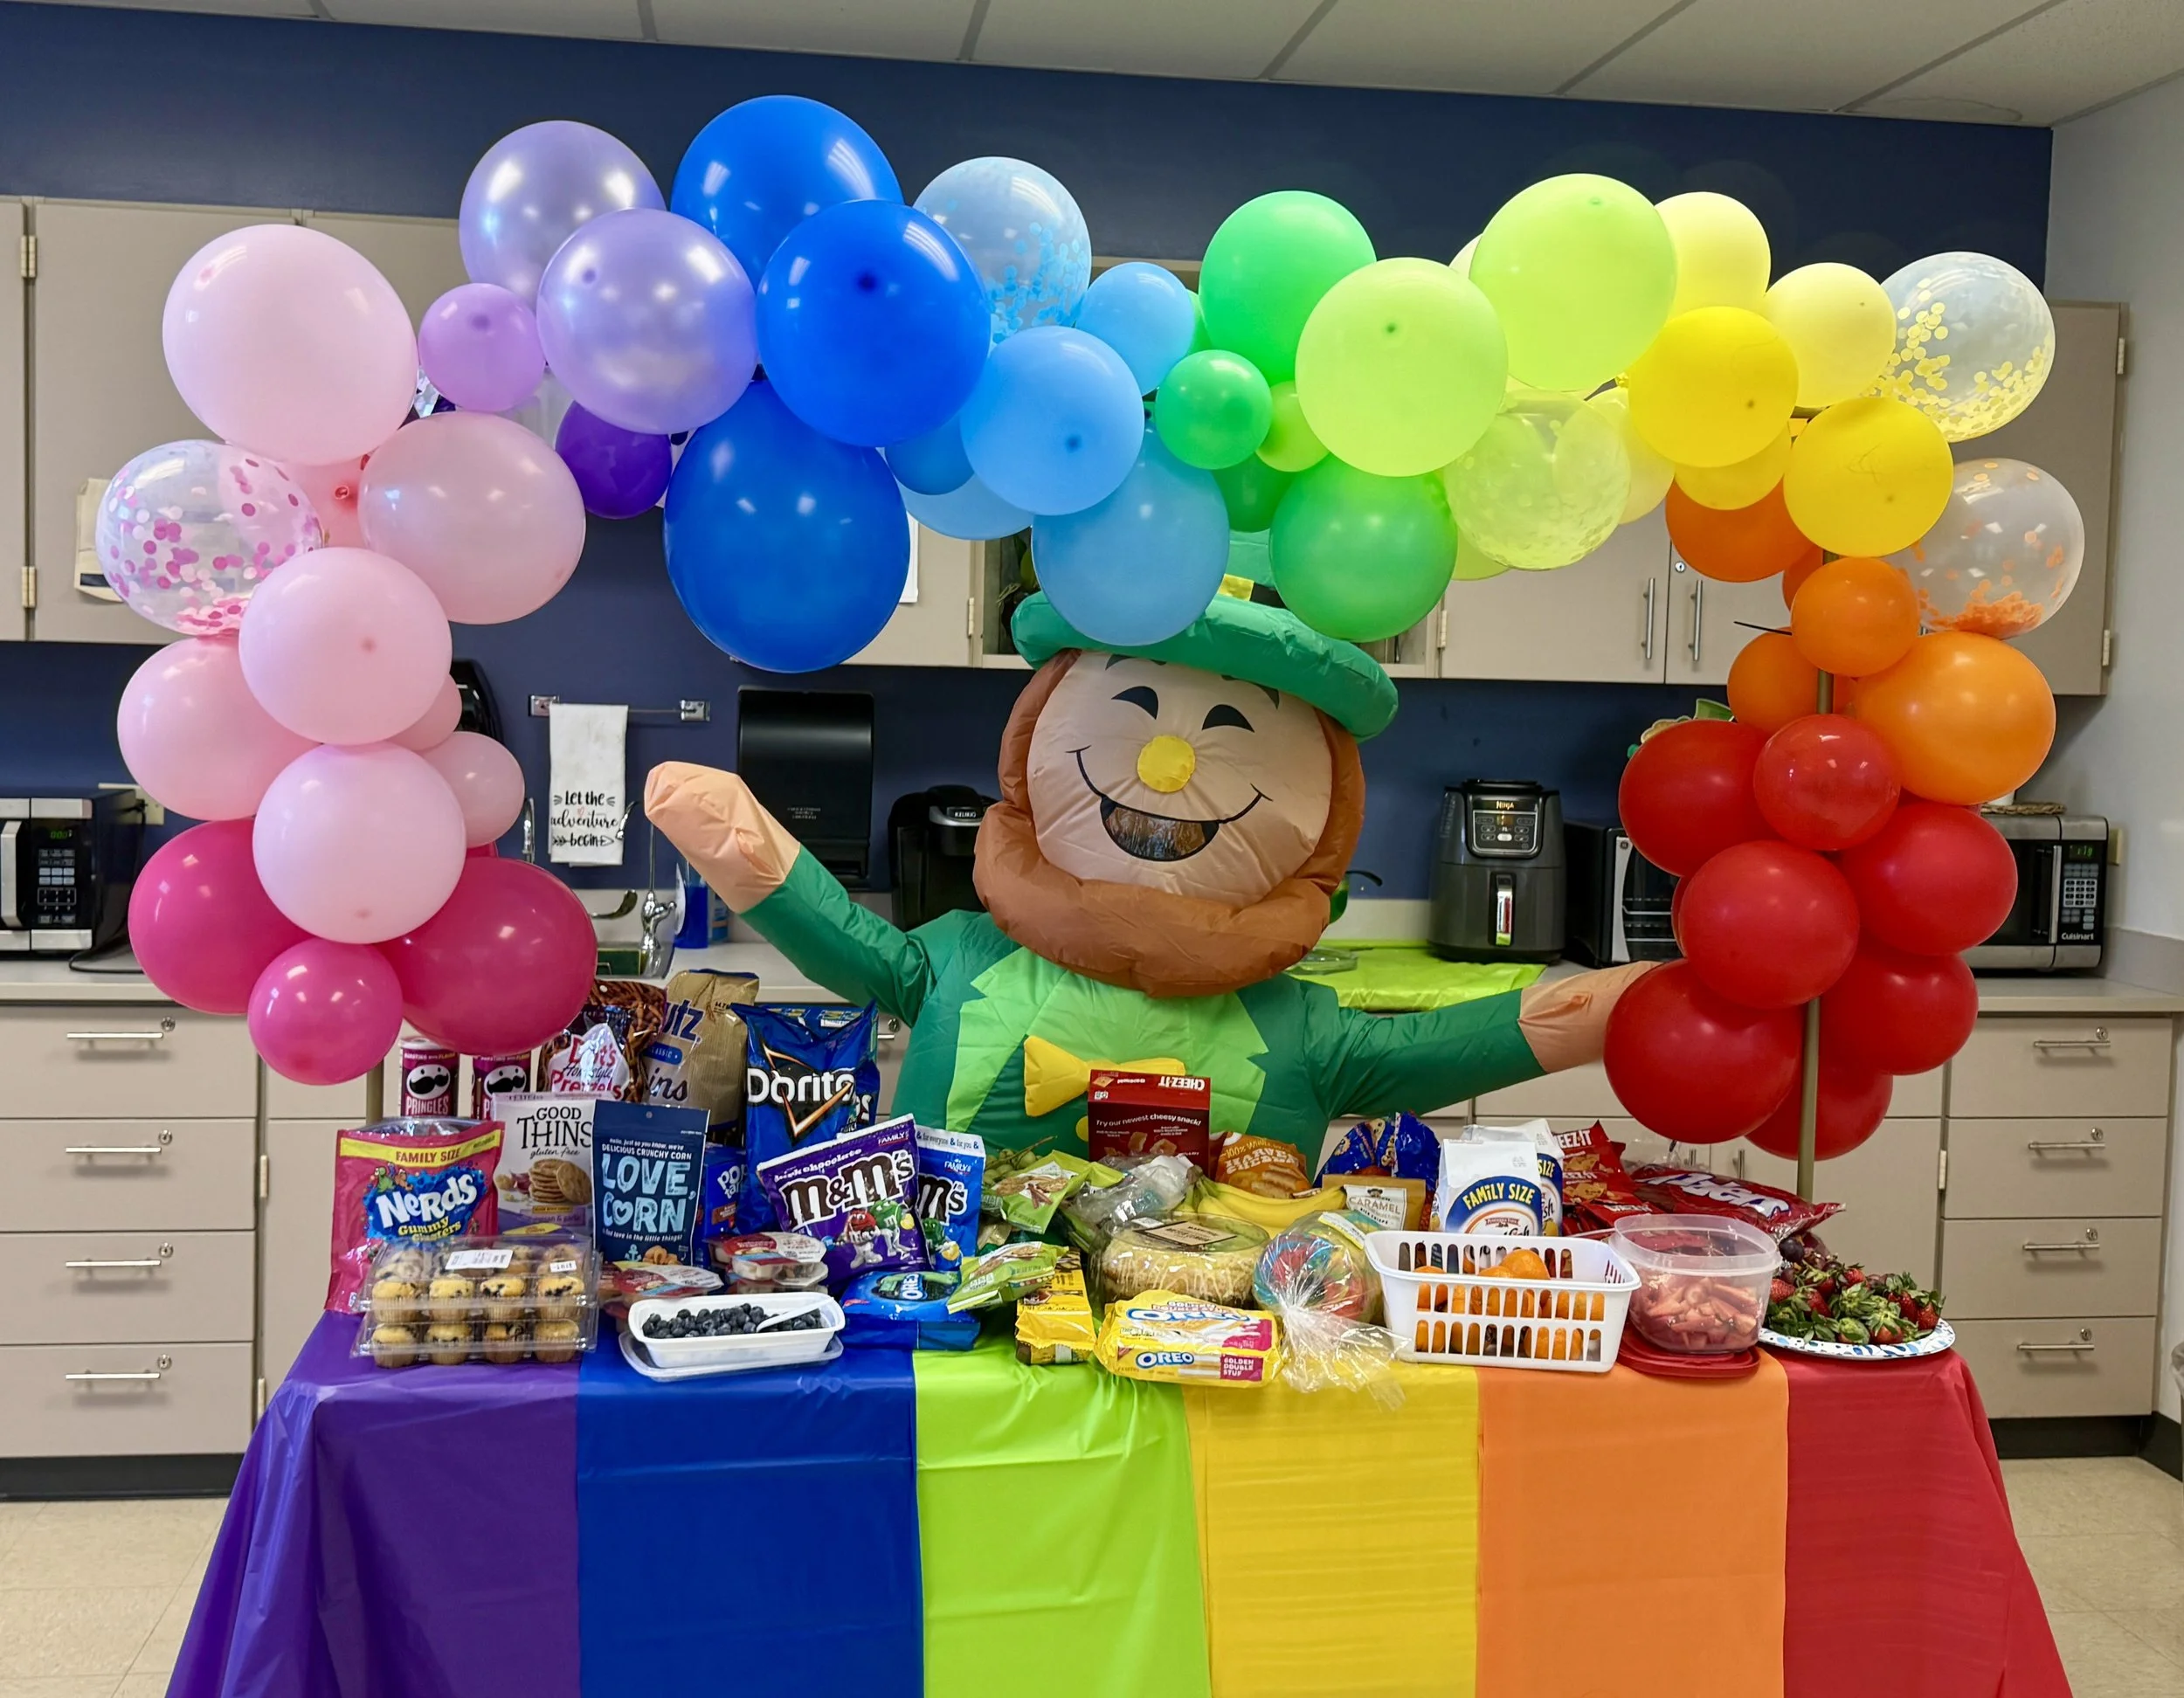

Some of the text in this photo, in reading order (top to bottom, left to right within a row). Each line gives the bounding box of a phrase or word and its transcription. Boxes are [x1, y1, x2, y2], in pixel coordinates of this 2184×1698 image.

[585, 790, 605, 805] the
[550, 809, 619, 829] adventure
[2061, 932, 2094, 941] Cuisinart
[747, 1067, 855, 1105] Dorito
[405, 1094, 450, 1116] PRINGLES
[536, 1106, 582, 1121] GOOD
[1096, 1119, 1108, 1128] Try
[1123, 1115, 1150, 1125] newest
[1150, 1113, 1177, 1122] cheesy
[516, 1115, 592, 1149] THINS
[878, 1130, 906, 1145] FAMILY
[1558, 1130, 1592, 1149] EEZ-IT
[602, 1143, 692, 1160] DELICIOUS CRUNCHY CORN
[950, 1137, 956, 1146] &
[973, 1141, 979, 1149] &
[396, 1147, 461, 1163] FAMILY SIZE
[529, 1148, 581, 1159] gluten free
[802, 1149, 862, 1174] chocolate
[1538, 1159, 1556, 1178] SIZE
[1508, 1184, 1536, 1205] SIZE
[1349, 1196, 1401, 1215] CARAMEL
[397, 1216, 450, 1236] Gummy
[1137, 1351, 1194, 1368] OREO
